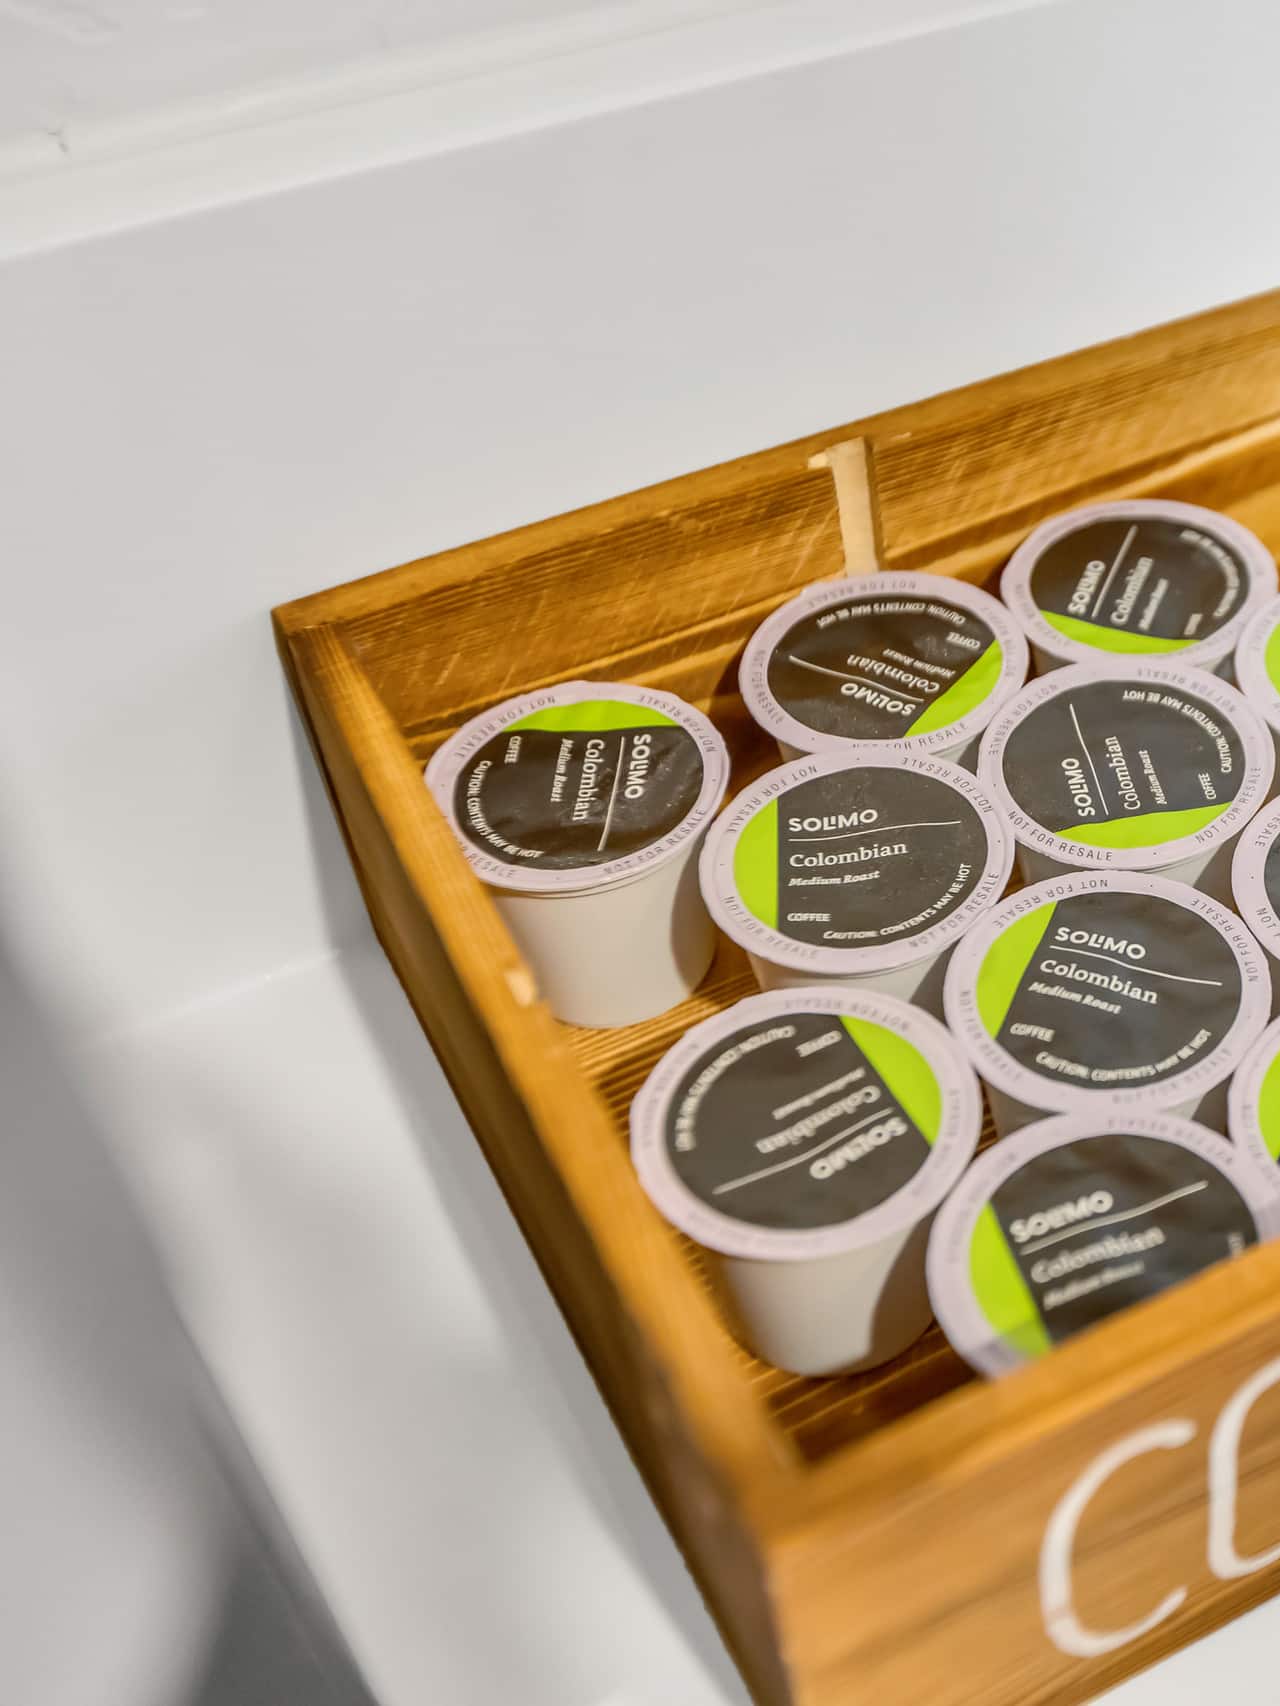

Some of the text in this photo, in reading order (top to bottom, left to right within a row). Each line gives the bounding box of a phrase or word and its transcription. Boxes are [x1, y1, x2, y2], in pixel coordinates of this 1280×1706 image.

[946, 632, 980, 650] COFFEE
[847, 654, 940, 694] Colombian
[841, 682, 915, 717] SOLIMO
[505, 736, 521, 763] COFFEE
[1122, 690, 1232, 773] CAUTION: CONTENTS MAY BE HOT
[572, 739, 604, 821] Colombian
[625, 734, 650, 798] SOLIMO
[902, 756, 993, 814] NOT FOR RESALE
[1061, 758, 1096, 817] SOLIMO
[1105, 736, 1140, 810] Colombian
[1139, 750, 1168, 805] Medium Roast
[1198, 772, 1217, 800] COFFEE
[729, 767, 818, 833] NOT FOR RESALE
[788, 809, 878, 832] SOLIMO
[1194, 767, 1261, 844] NOT FOR RESALE
[789, 844, 908, 868] Colombian
[1007, 810, 1114, 862] NOT FOR RESALE
[788, 870, 881, 887] Medium Roast
[787, 913, 831, 922] COFFEE
[994, 880, 1108, 929] NOT FOR RESALE
[1256, 907, 1274, 928] NOT
[1055, 926, 1147, 960] SOLIMO
[1040, 959, 1158, 1005] Colombian
